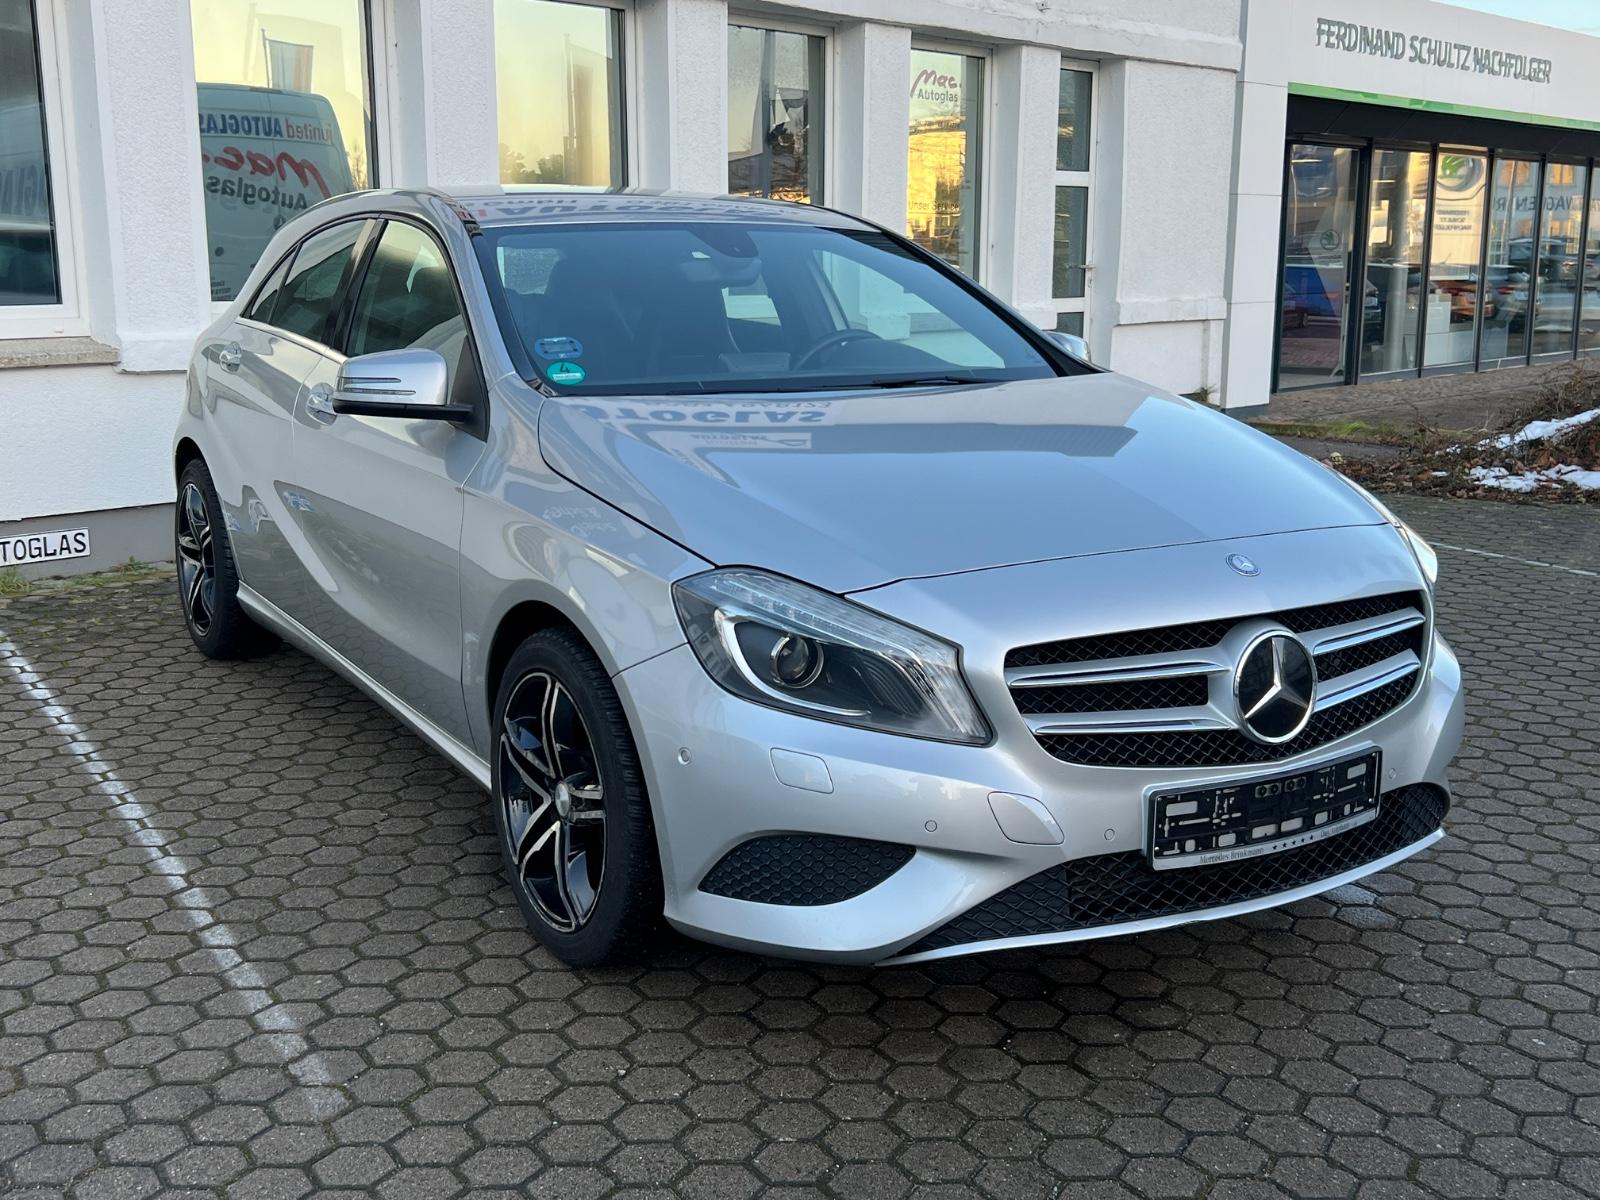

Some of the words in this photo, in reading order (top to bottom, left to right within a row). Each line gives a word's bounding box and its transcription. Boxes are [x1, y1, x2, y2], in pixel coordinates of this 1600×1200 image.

[1315, 17, 1405, 60] FERDINAND
[1408, 34, 1471, 71] SCHULTZ
[1473, 47, 1552, 84] NACHFOLGER
[918, 88, 959, 104] Autoglas
[560, 362, 571, 374] 4
[0, 532, 87, 562] TOGLAS
